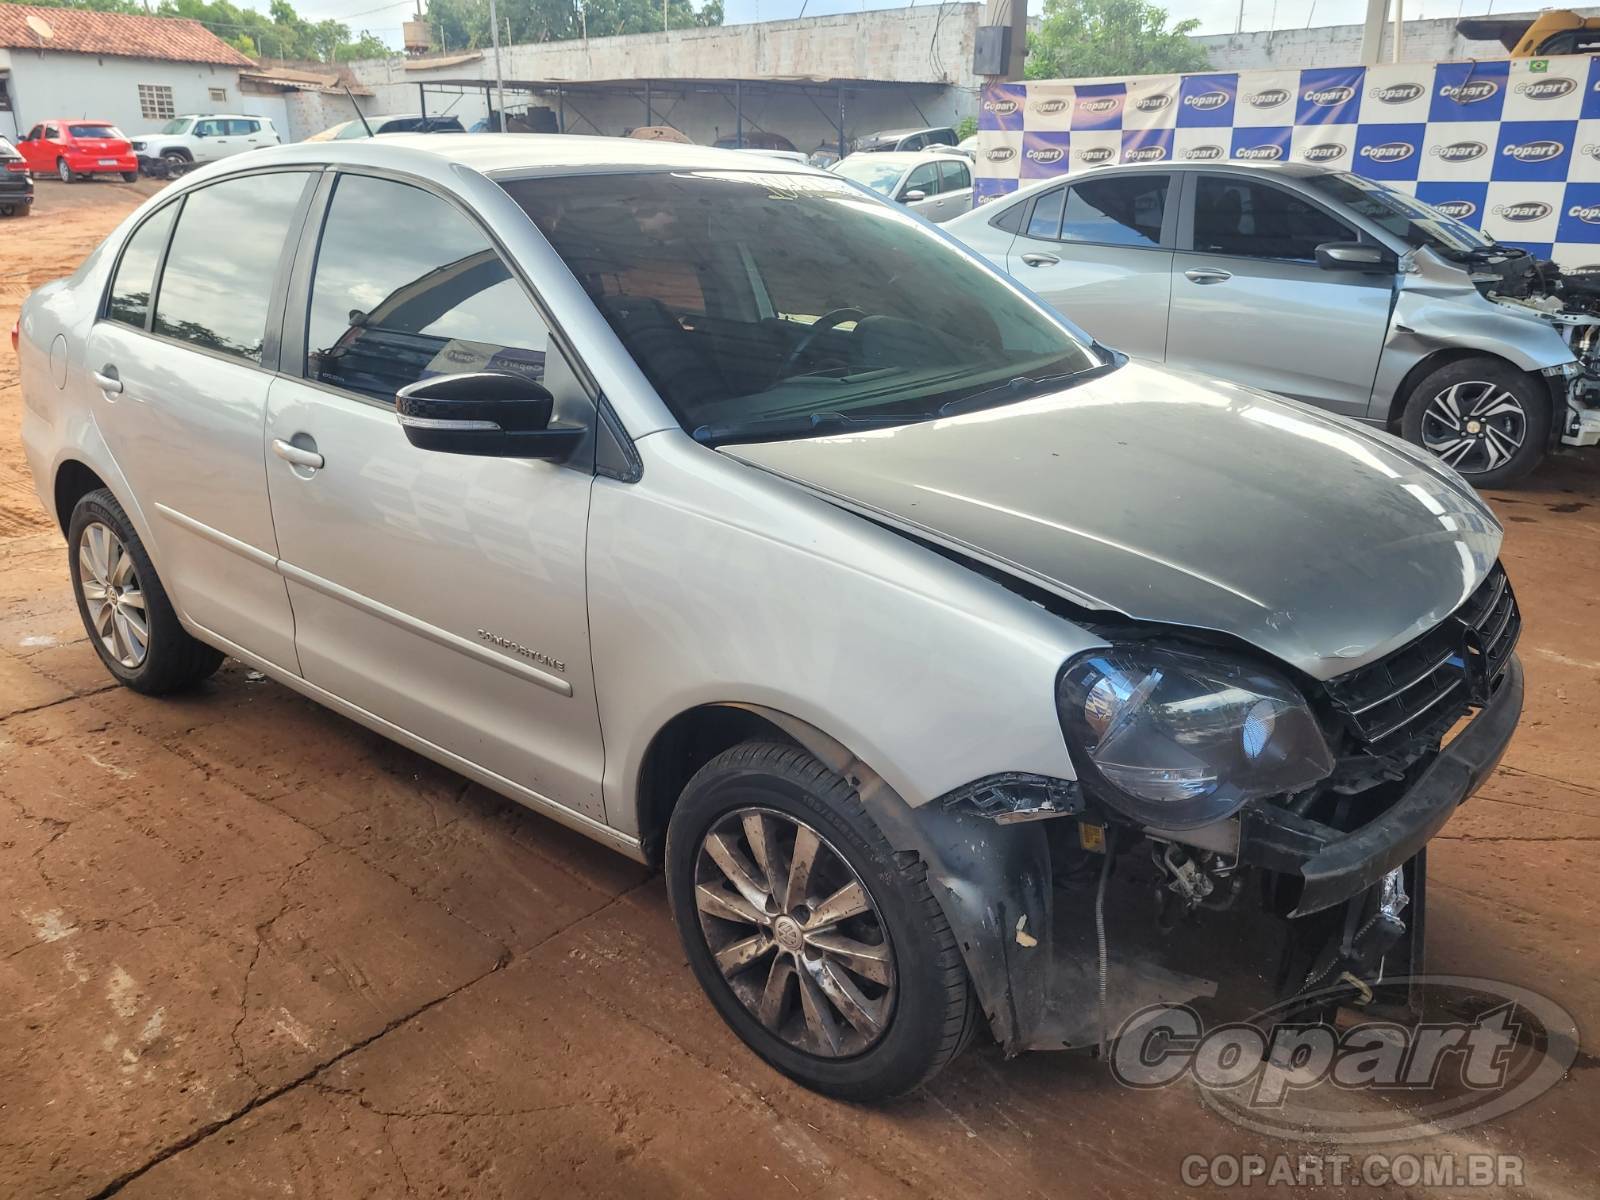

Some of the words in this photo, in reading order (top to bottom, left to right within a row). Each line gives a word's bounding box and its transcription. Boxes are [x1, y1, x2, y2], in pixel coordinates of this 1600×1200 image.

[1368, 84, 1417, 100] Copart
[1515, 80, 1567, 95] Copart
[1184, 93, 1223, 106] Copart
[1304, 88, 1349, 103] Copart
[984, 100, 1014, 112] Copart
[1080, 100, 1113, 112] Copart
[1026, 148, 1059, 161] Copart
[1125, 147, 1161, 161] Copart
[1236, 146, 1276, 159] Copart
[1360, 144, 1408, 159] Copart
[1429, 143, 1478, 159] Copart
[1502, 143, 1555, 158] Copart
[1492, 204, 1544, 218] Copart
